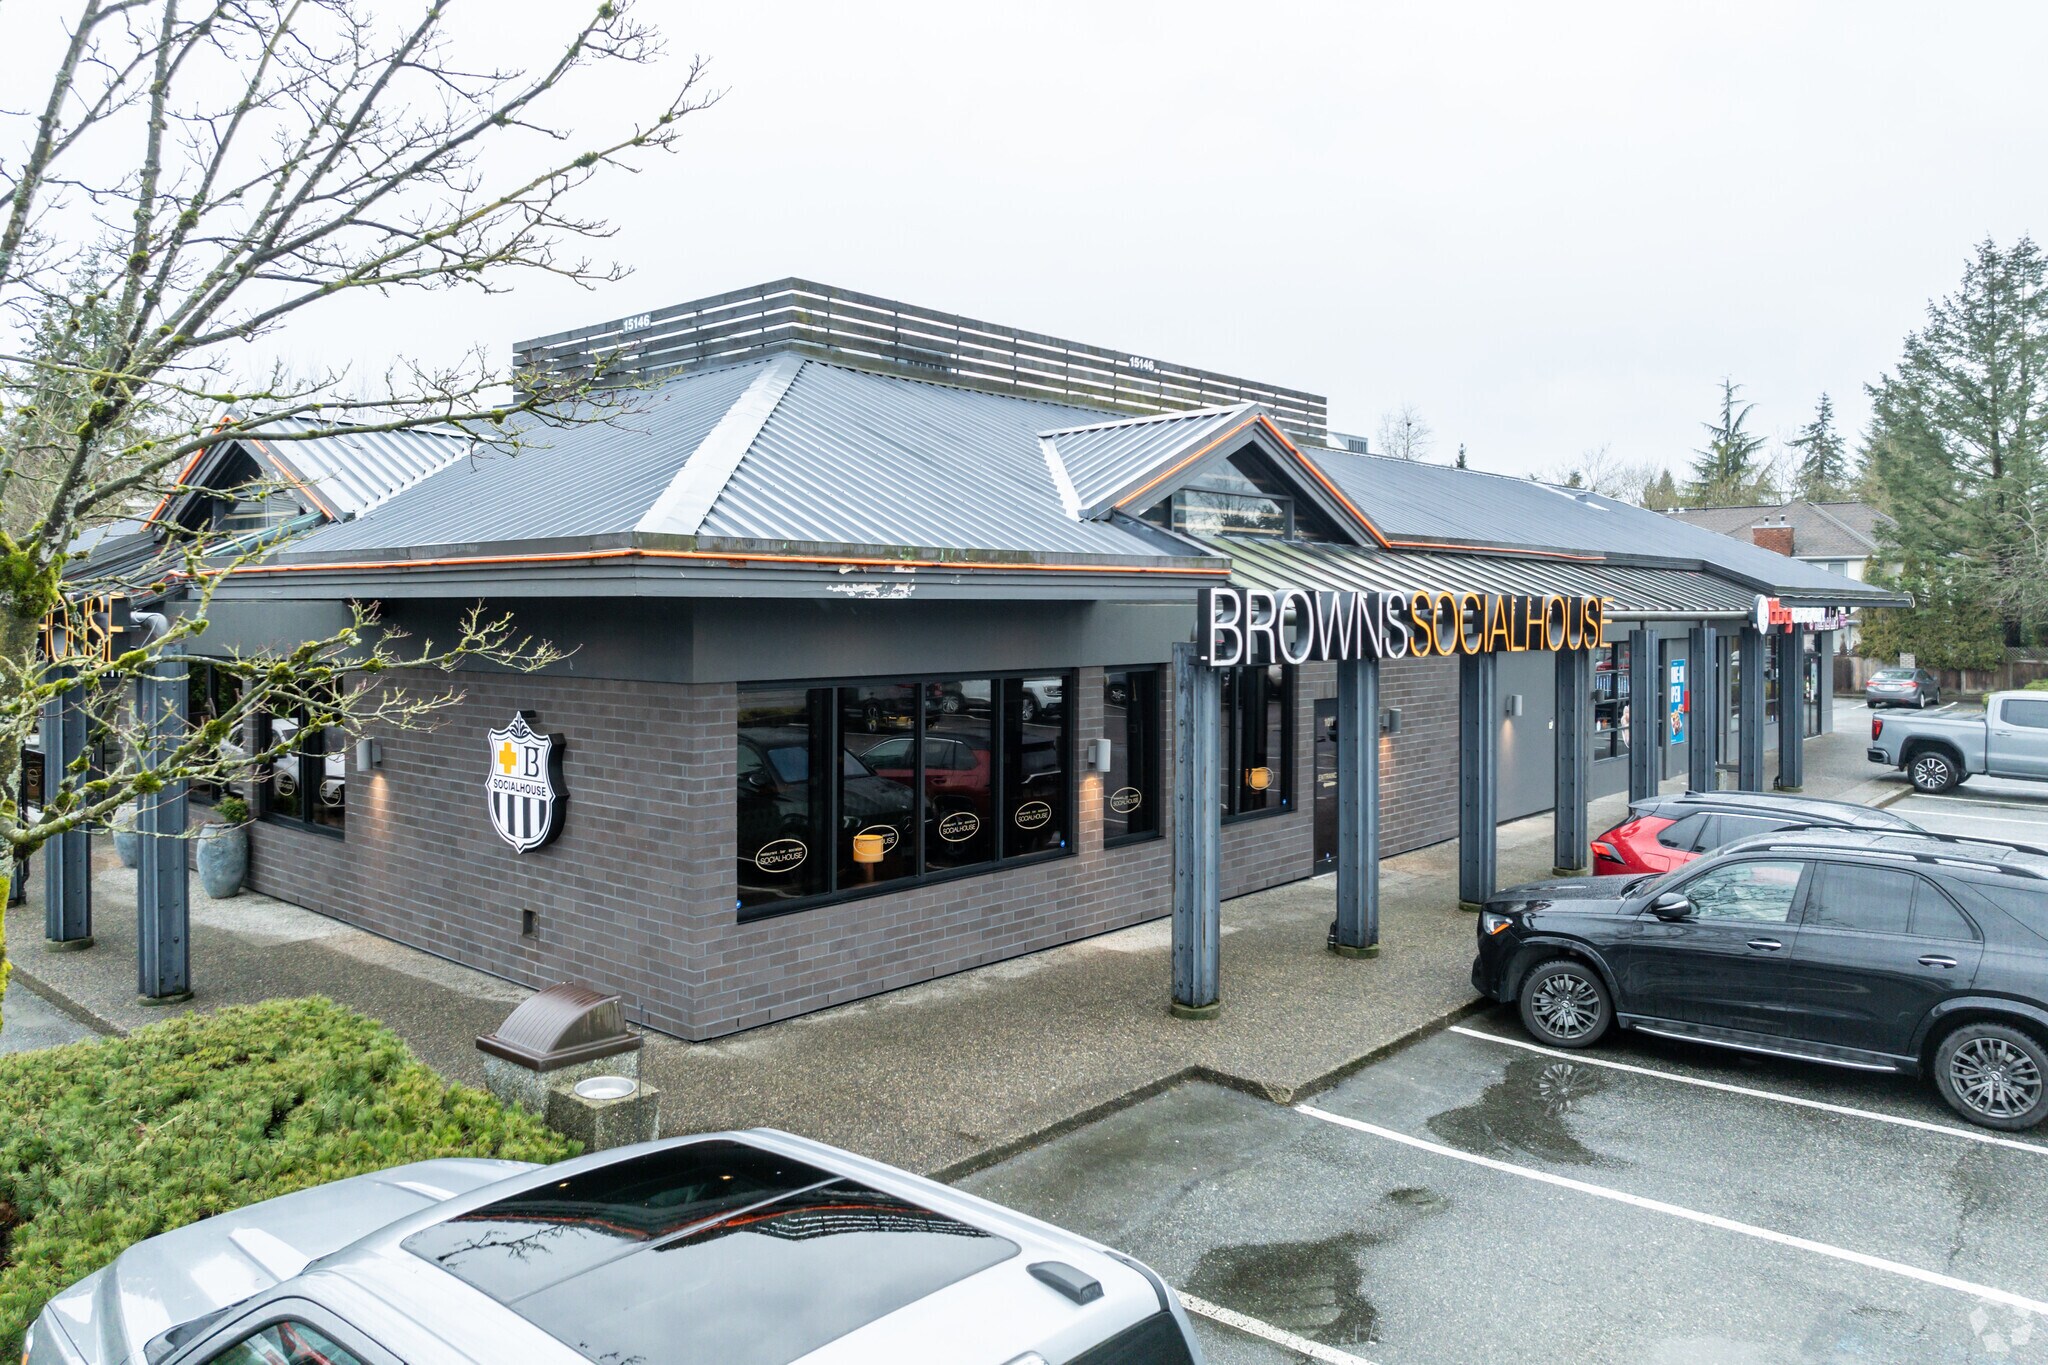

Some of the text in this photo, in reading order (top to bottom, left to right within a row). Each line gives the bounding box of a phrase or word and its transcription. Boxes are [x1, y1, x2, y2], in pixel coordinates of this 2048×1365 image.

[623, 314, 650, 331] 15146
[1129, 356, 1154, 371] 15146
[1210, 587, 1614, 666] BROWNS SOCIALHOUSE
[523, 745, 540, 778] B
[493, 778, 547, 797] SOCIALHOUSE
[942, 823, 976, 835] SOCIALHOUSE
[760, 851, 803, 865] SOCIALHOUSE
